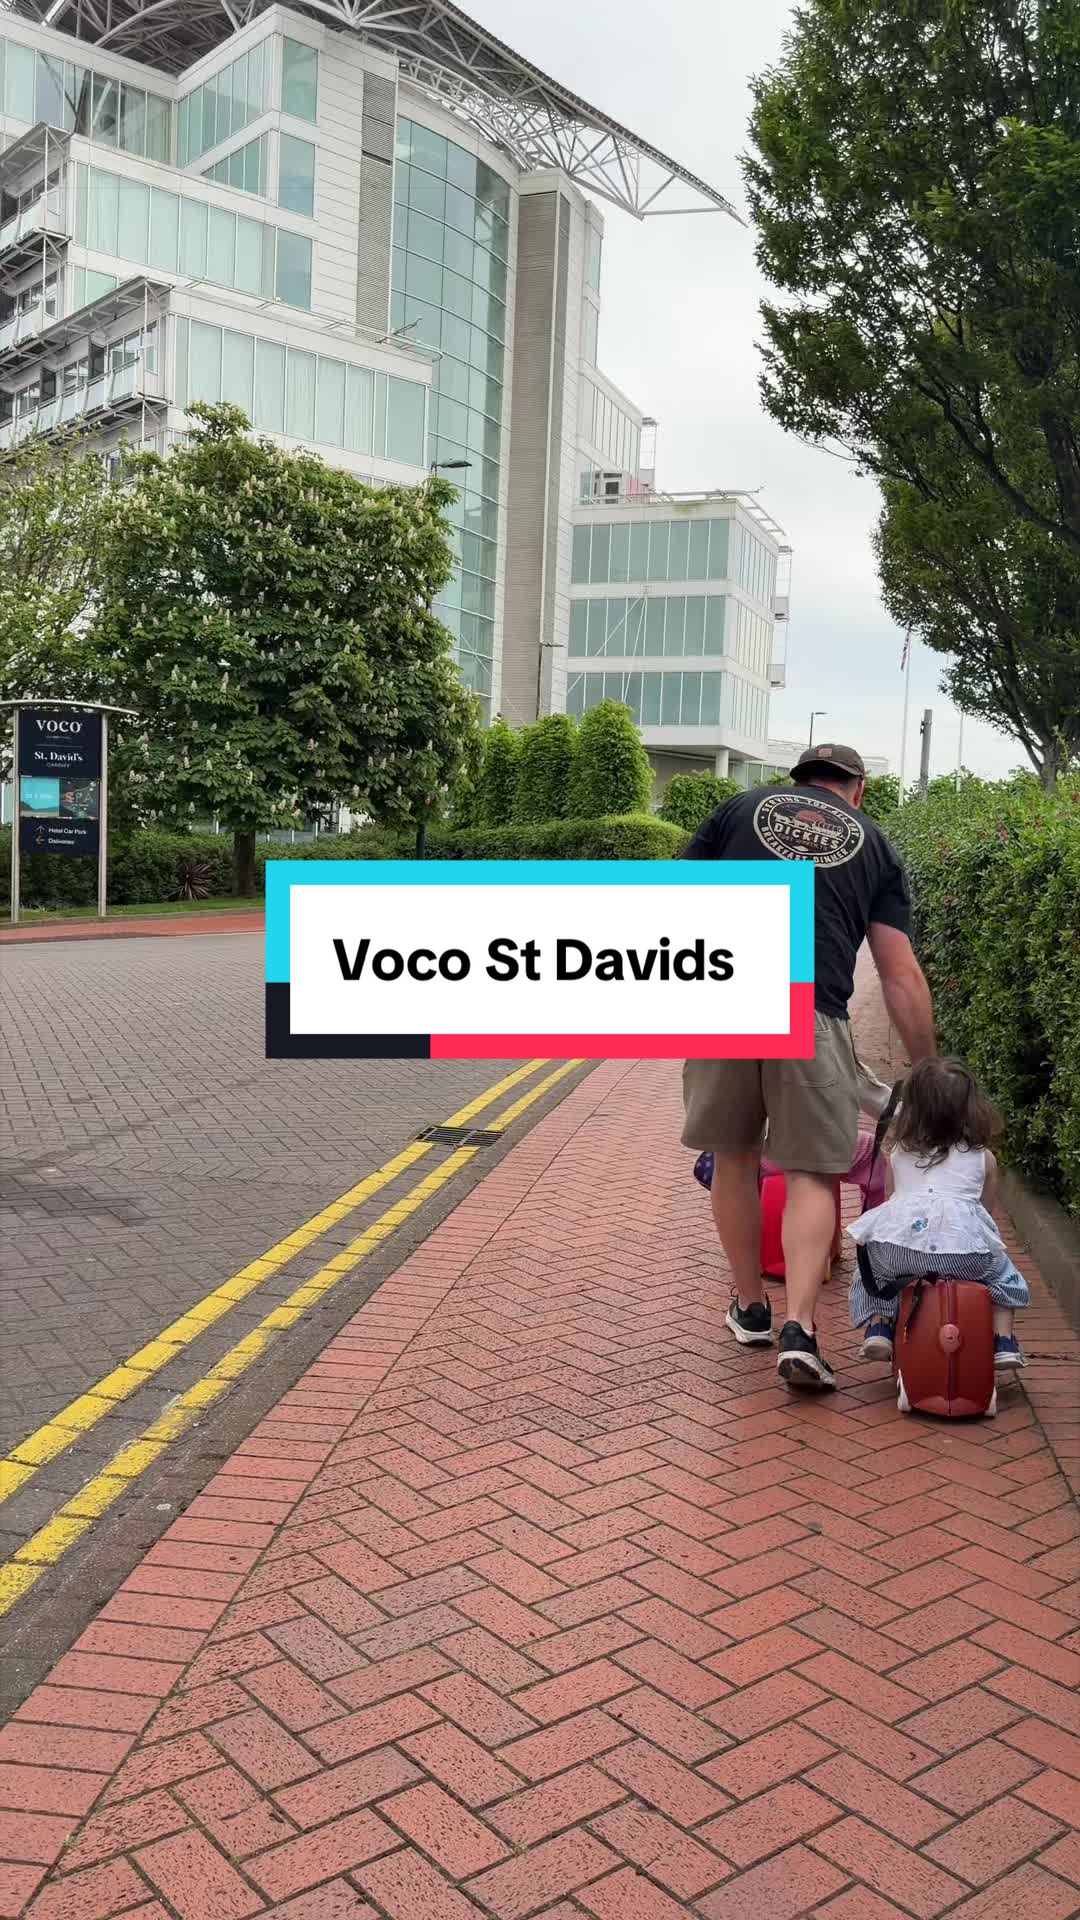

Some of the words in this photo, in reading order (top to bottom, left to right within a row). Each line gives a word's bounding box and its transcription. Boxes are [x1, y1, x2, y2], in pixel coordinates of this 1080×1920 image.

[34, 751, 48, 760] St.
[50, 752, 83, 761] David's
[761, 796, 800, 812] SERVING
[808, 800, 827, 809] YOU
[832, 810, 848, 821] ALL
[848, 822, 860, 837] DAY
[761, 826, 808, 860] BREAKFAST
[814, 848, 849, 864] DINNER
[773, 822, 839, 849] DICKIES
